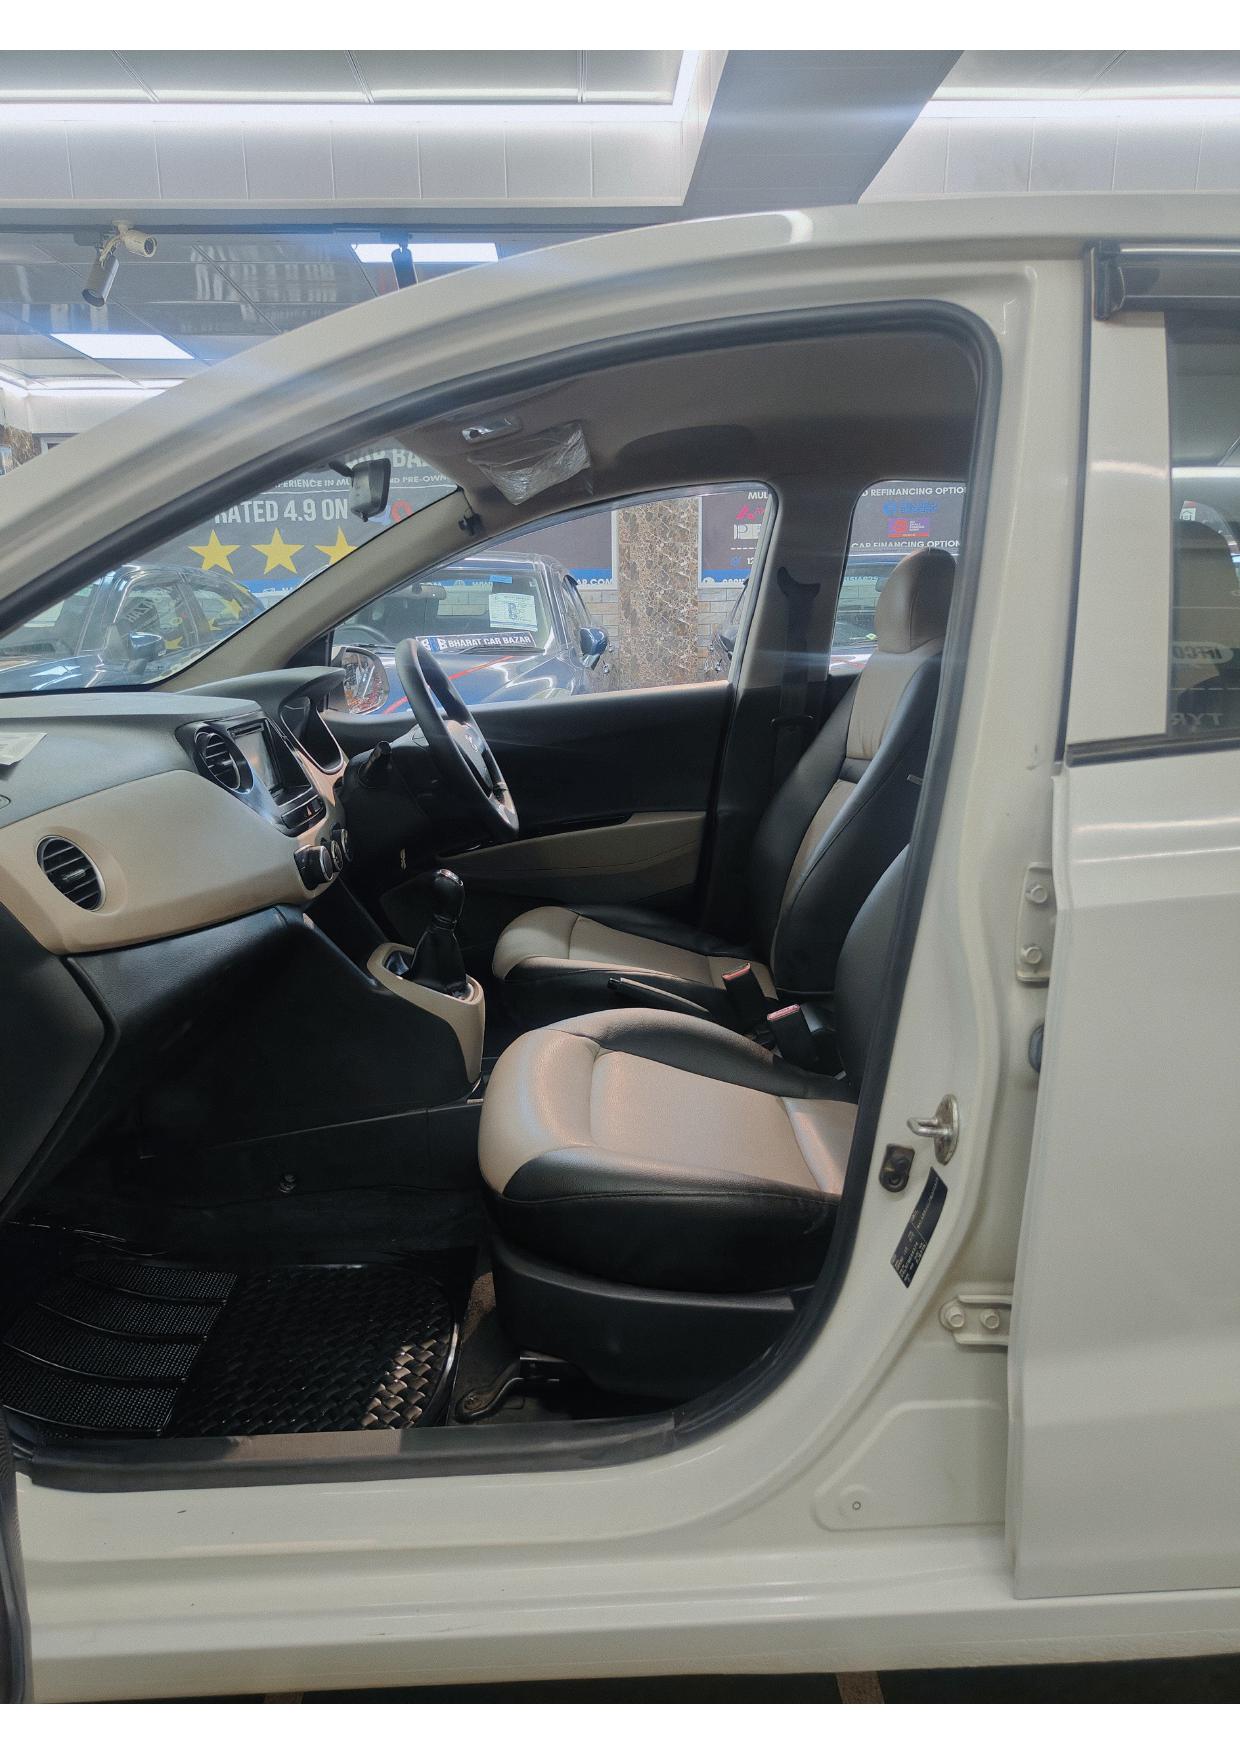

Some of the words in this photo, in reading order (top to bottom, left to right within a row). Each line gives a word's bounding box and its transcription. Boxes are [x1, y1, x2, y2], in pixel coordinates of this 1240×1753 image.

[871, 487, 932, 496] REFINANCING
[935, 486, 967, 495] OPTIO
[214, 500, 279, 524] RATED
[283, 498, 316, 523] 4.9
[322, 498, 348, 522] ON
[448, 638, 482, 648] BHARAT
[483, 637, 502, 646] CAR
[503, 636, 531, 645] BAZAR
